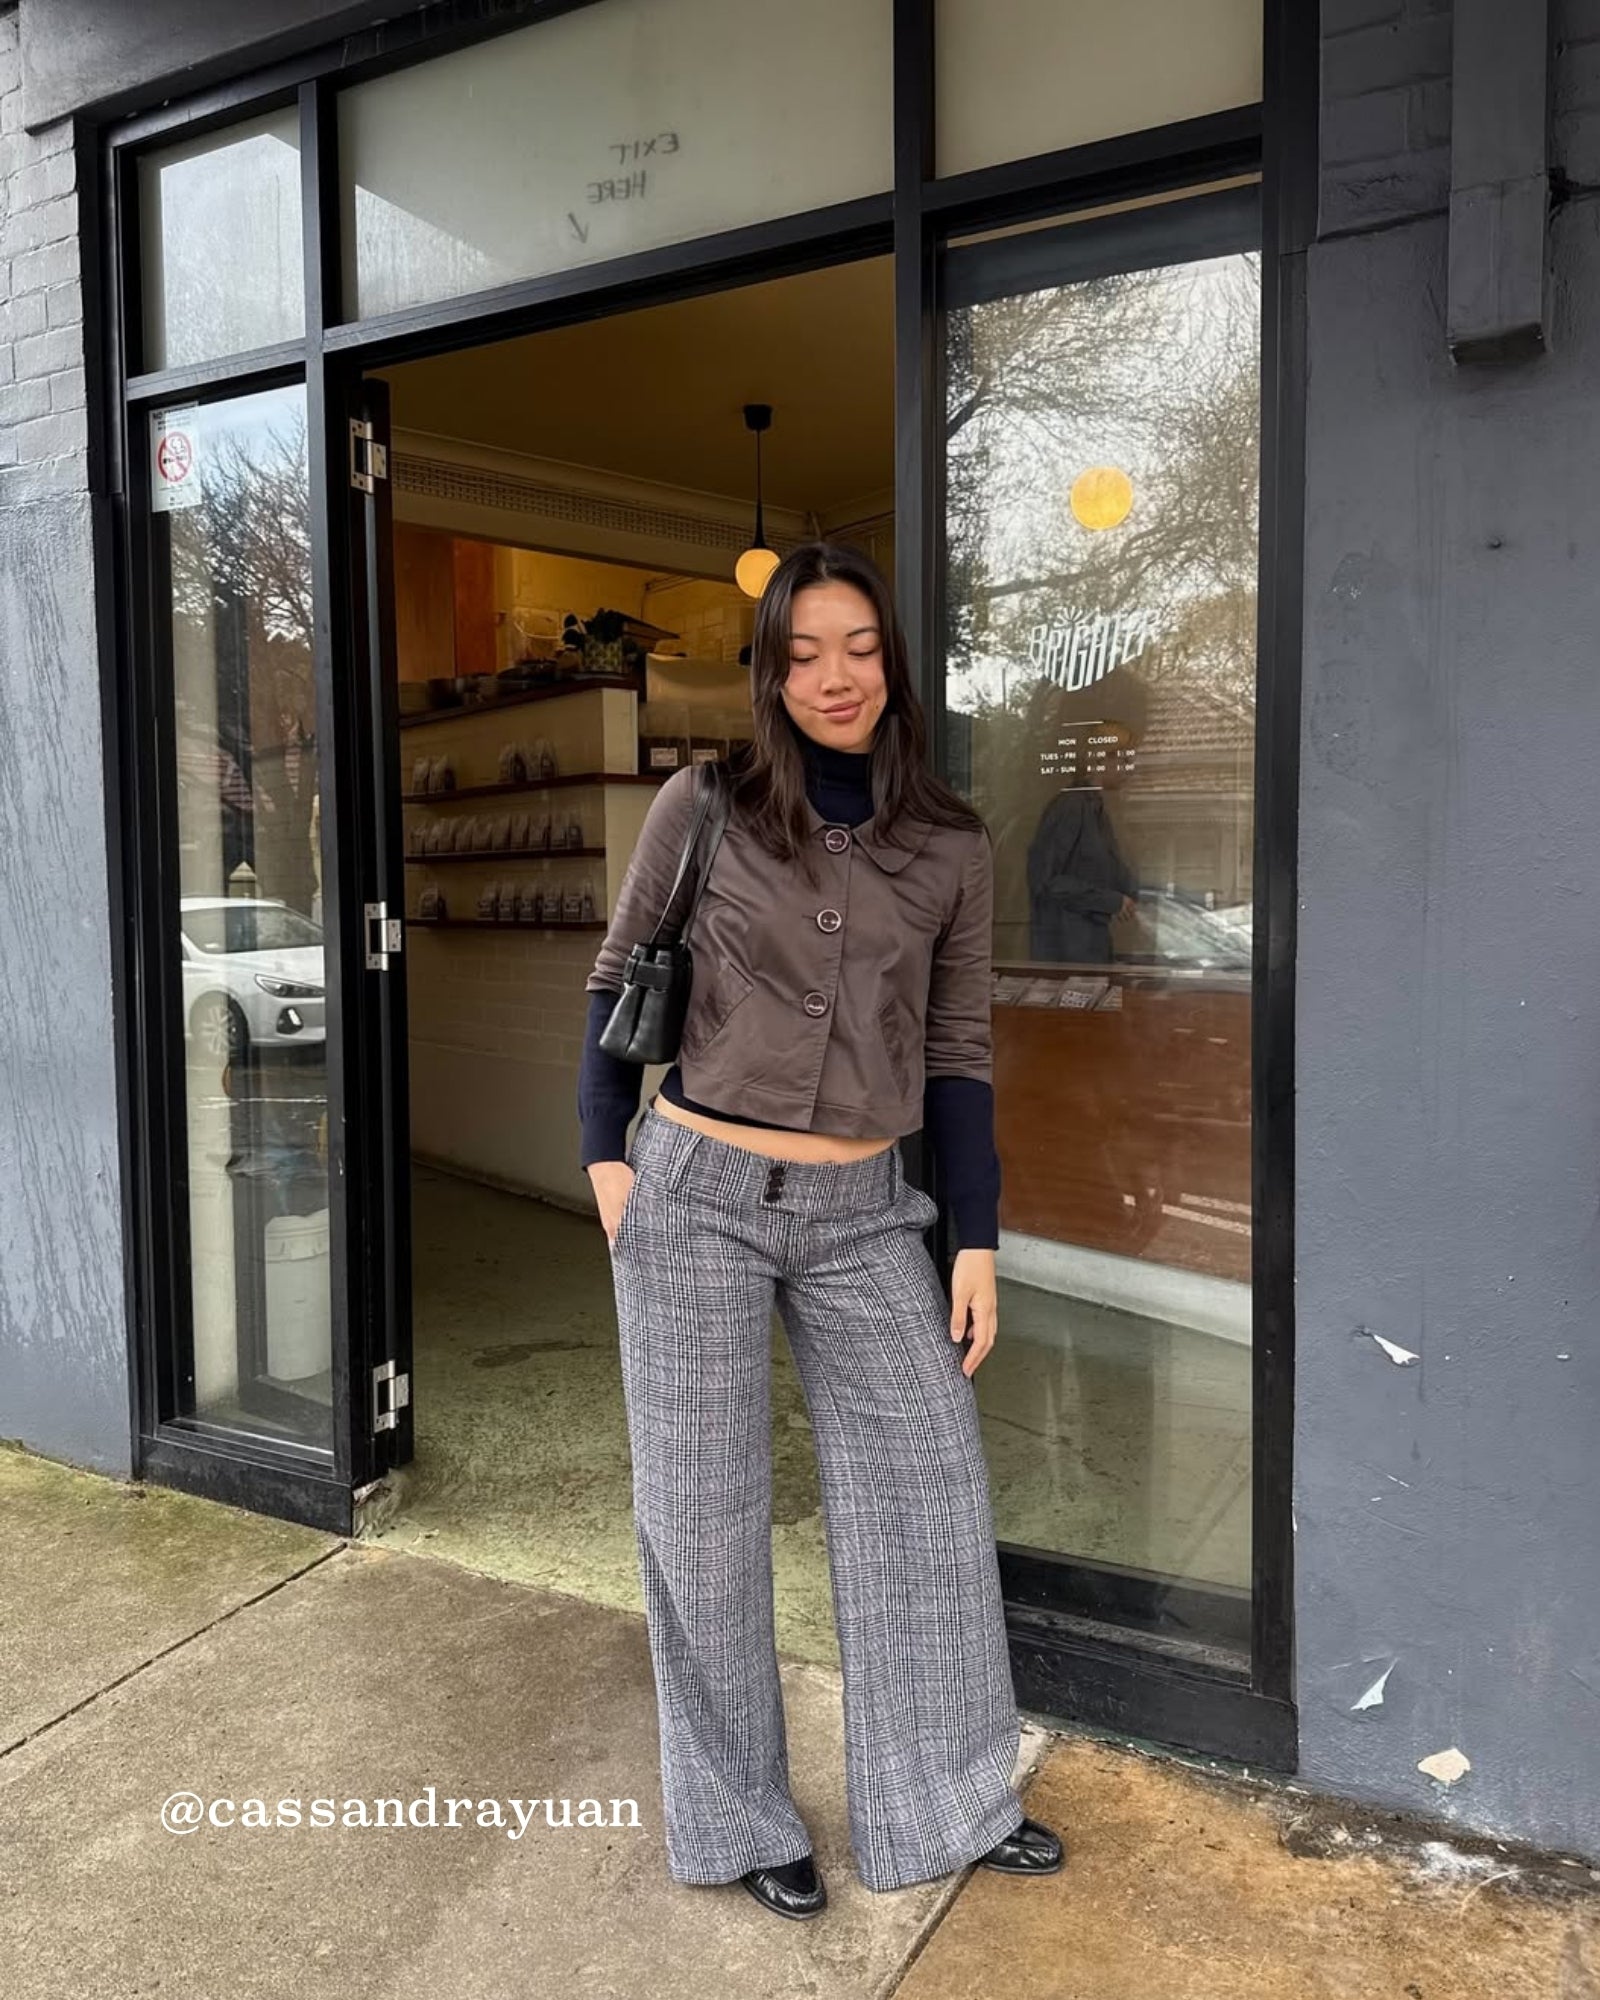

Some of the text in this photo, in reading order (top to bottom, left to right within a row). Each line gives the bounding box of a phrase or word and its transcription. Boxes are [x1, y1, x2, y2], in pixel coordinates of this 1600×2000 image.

[1029, 608, 1161, 692] BRIGHTER
[1041, 753, 1058, 761] TUES
[1064, 752, 1076, 760] FRI
[1040, 767, 1054, 775] SAT
[1060, 766, 1076, 774] SUN
